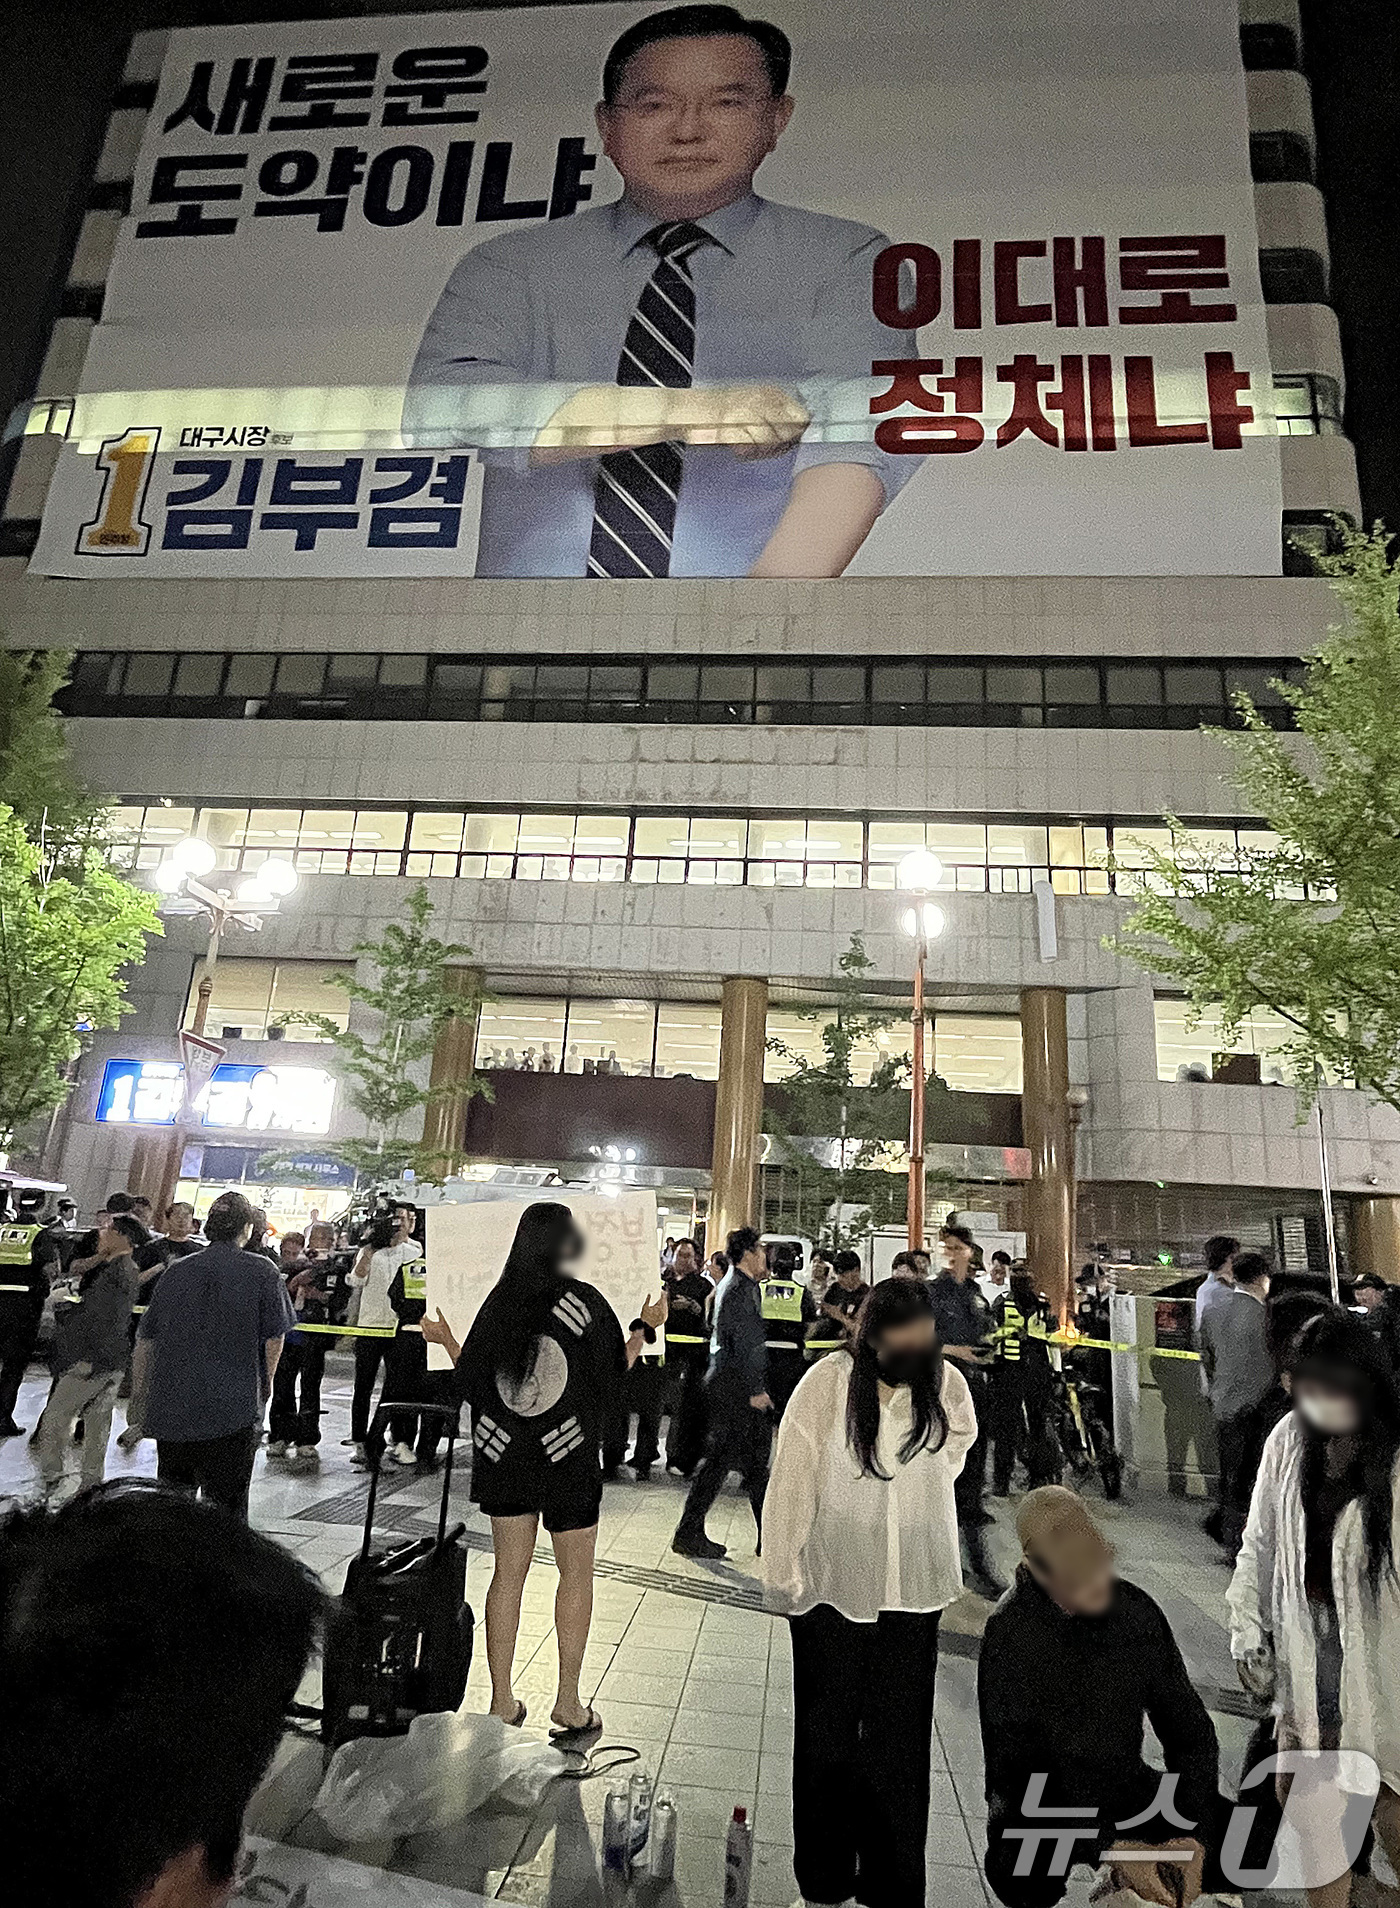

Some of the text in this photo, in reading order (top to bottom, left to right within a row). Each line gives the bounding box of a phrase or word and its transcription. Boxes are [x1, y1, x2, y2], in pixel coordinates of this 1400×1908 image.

[163, 45, 489, 135] 새로운
[135, 137, 597, 239] 도약이냐
[872, 234, 1238, 330] 이대로
[179, 426, 271, 447] 대구시장
[869, 351, 1255, 455] 정체냐
[76, 427, 161, 555] 1
[161, 453, 469, 551] 김부겸
